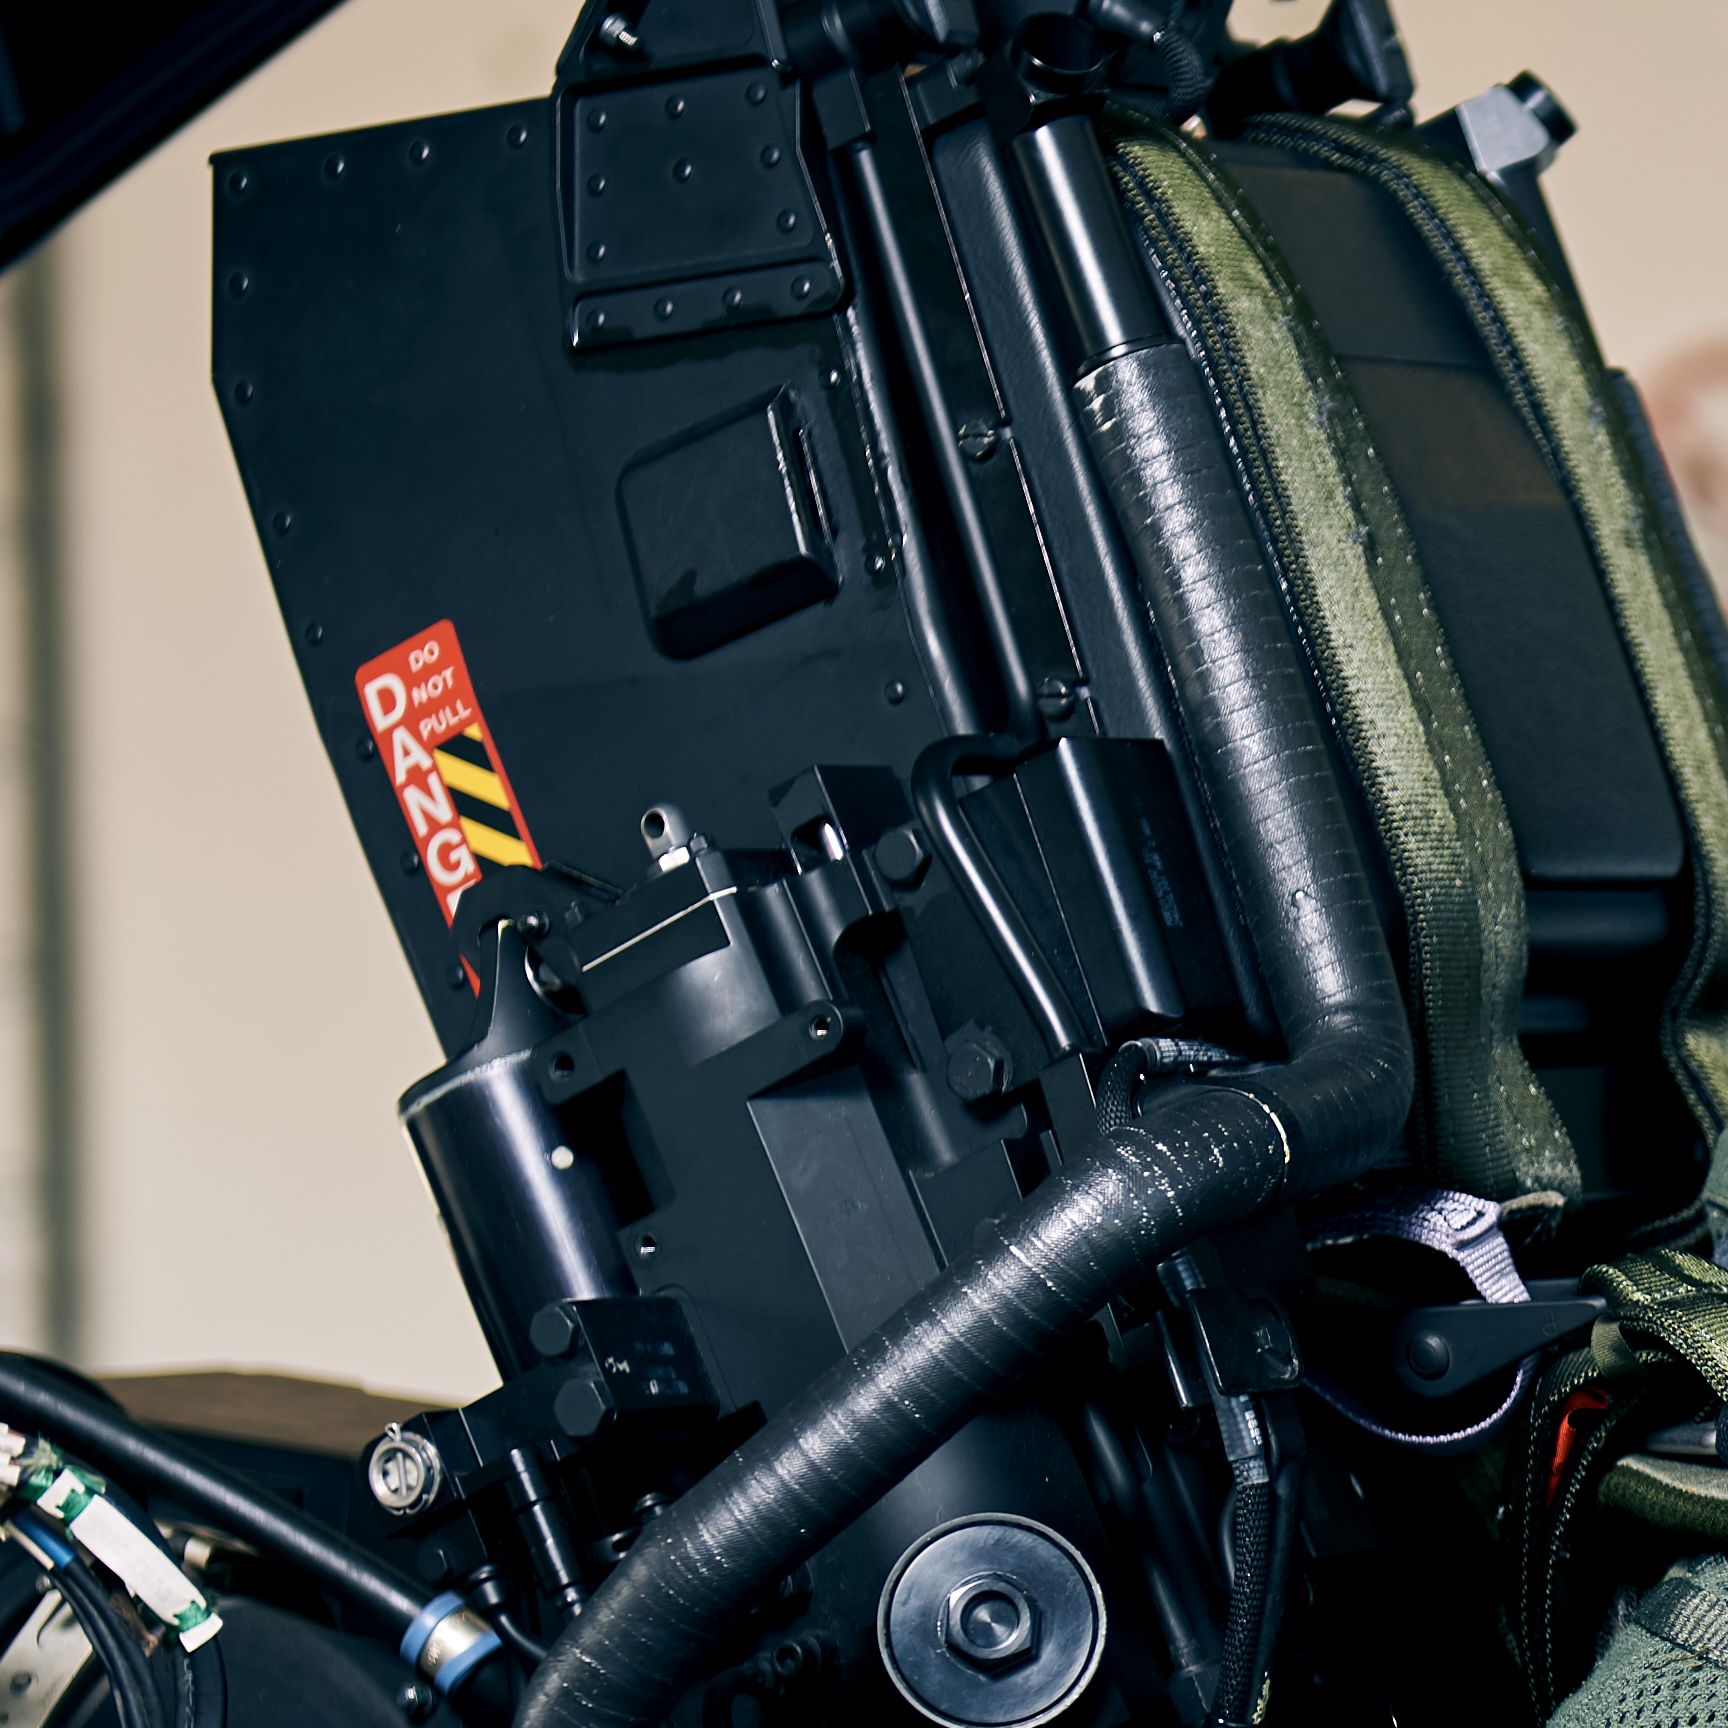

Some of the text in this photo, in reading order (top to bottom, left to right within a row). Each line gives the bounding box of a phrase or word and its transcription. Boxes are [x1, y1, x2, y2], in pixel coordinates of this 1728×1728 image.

[408, 640, 440, 674] DO
[411, 666, 454, 708] NOT
[418, 698, 472, 742] PULL
[363, 672, 477, 917] DANG
